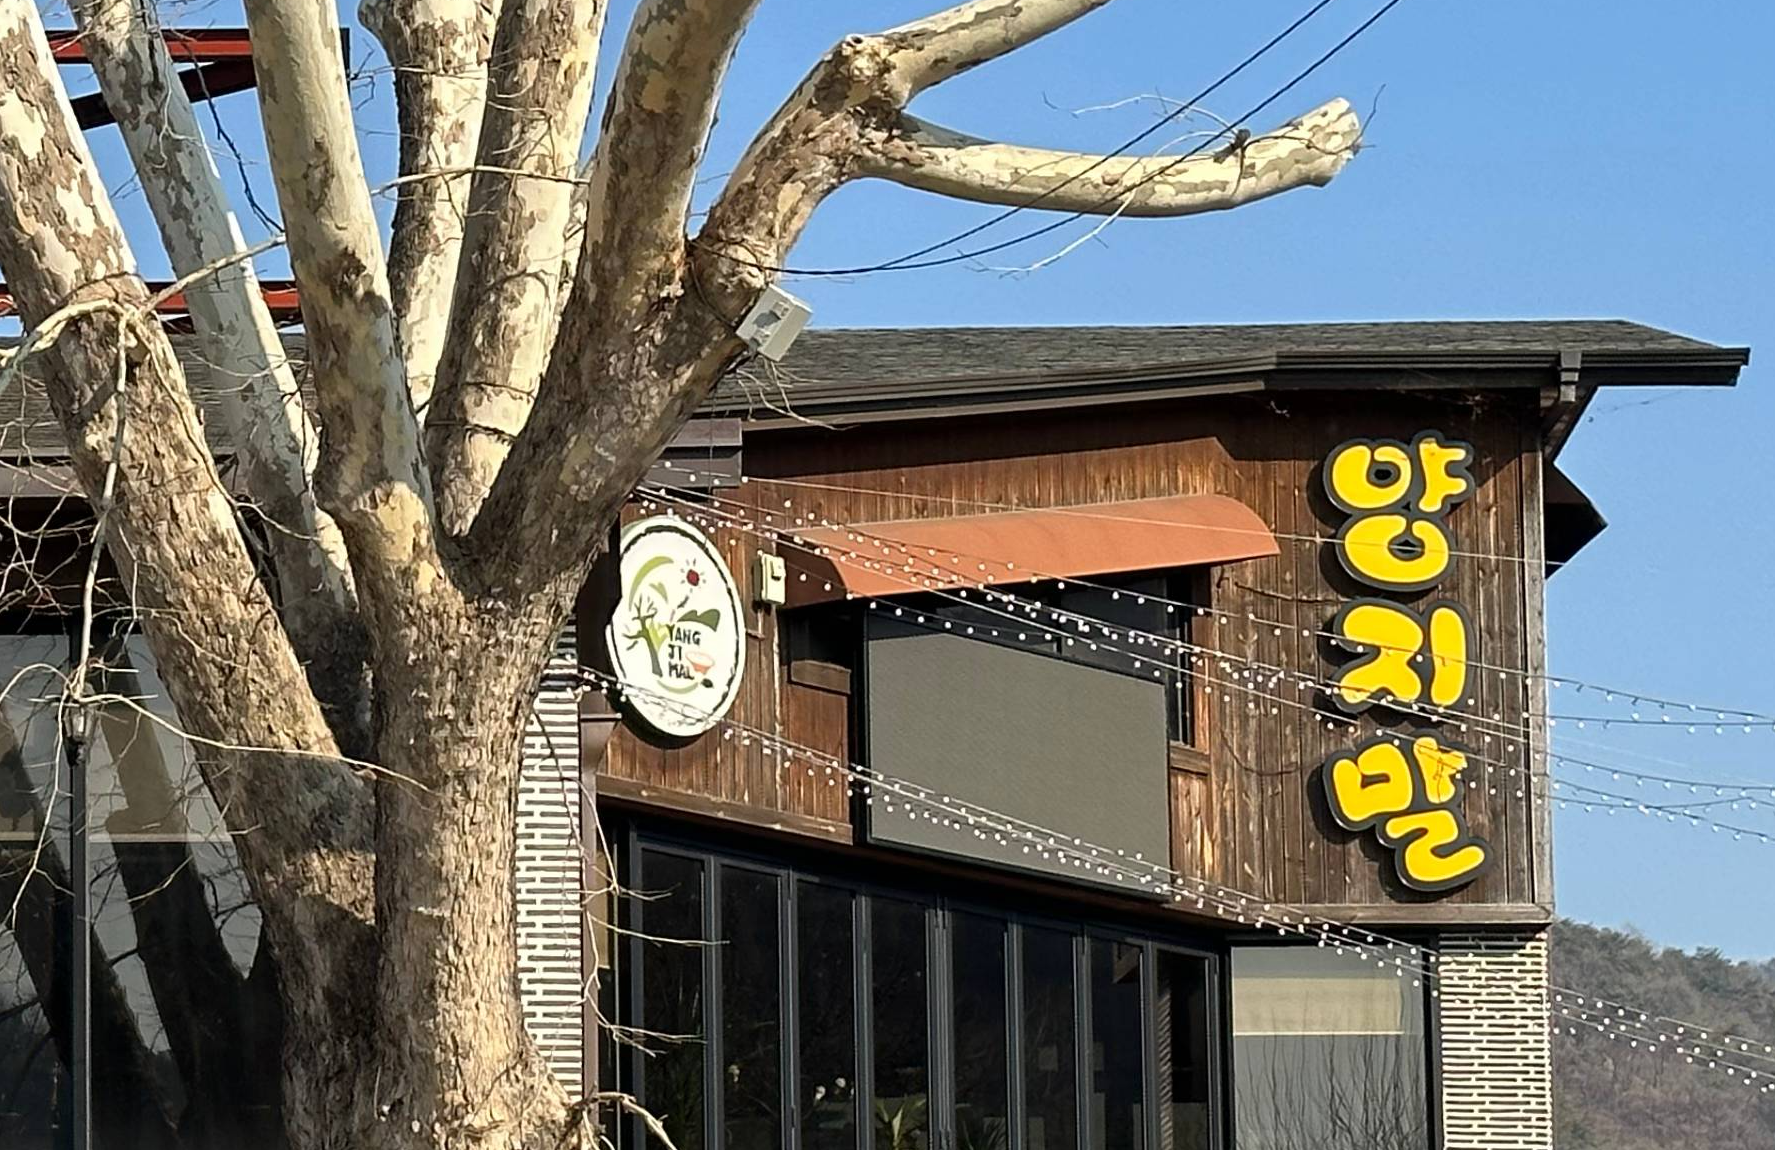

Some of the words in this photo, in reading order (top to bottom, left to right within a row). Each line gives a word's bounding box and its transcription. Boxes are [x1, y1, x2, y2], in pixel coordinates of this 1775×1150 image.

[665, 624, 701, 646] YANG
[668, 644, 682, 661] JI
[1324, 429, 1492, 891] 양지말
[669, 661, 695, 681] MAL
